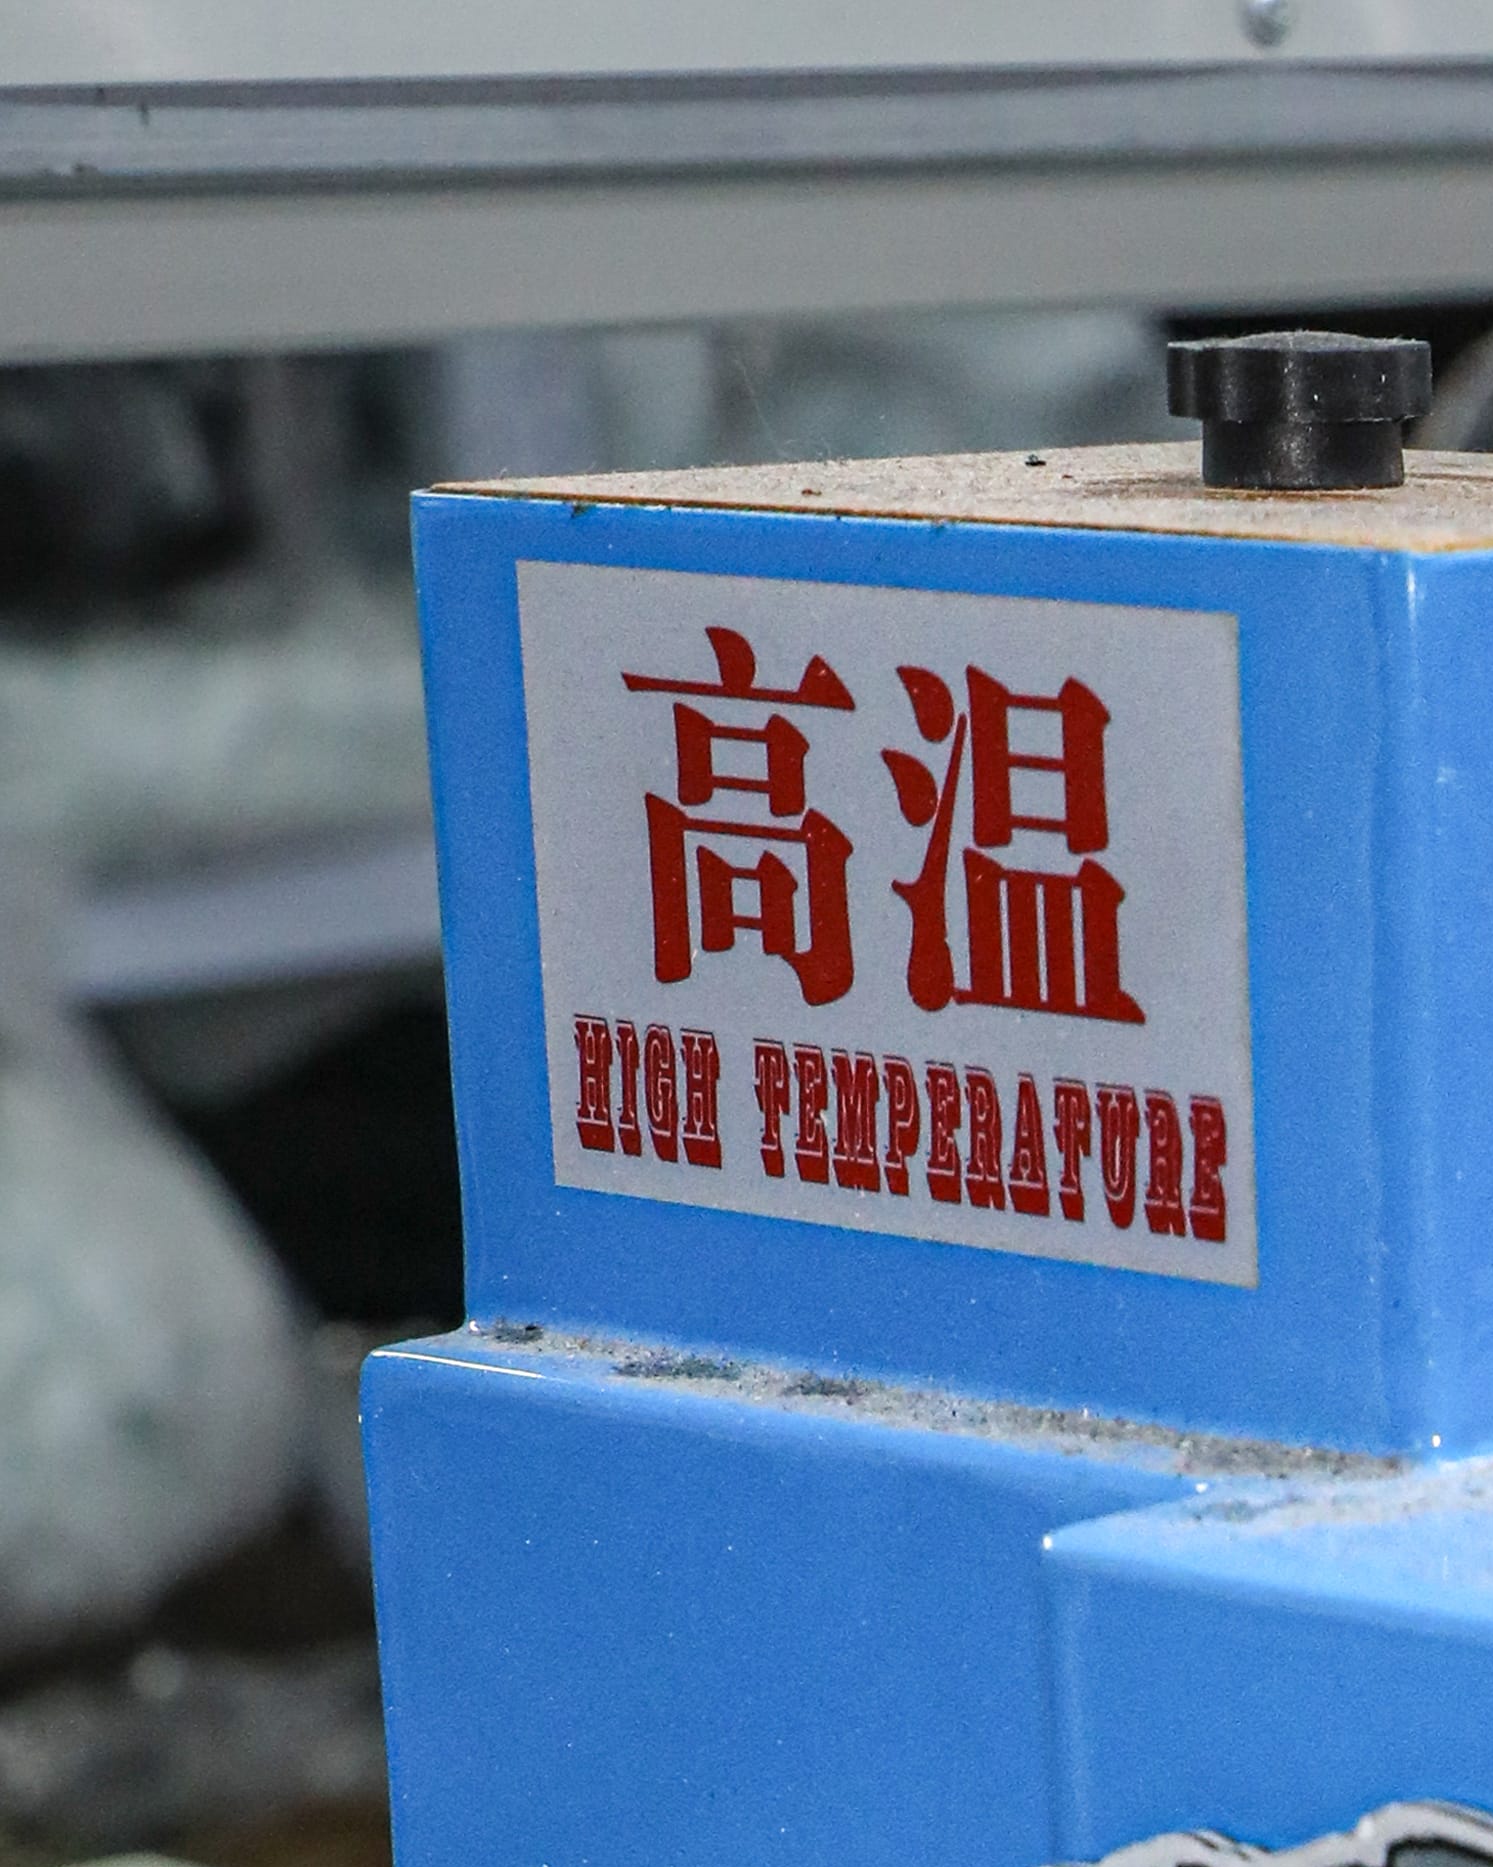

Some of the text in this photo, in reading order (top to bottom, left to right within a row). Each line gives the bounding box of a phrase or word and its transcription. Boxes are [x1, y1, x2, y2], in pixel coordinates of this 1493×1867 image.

[621, 627, 1146, 1025] 高温
[574, 1013, 1228, 1243] HIGH TEMPERATURE
